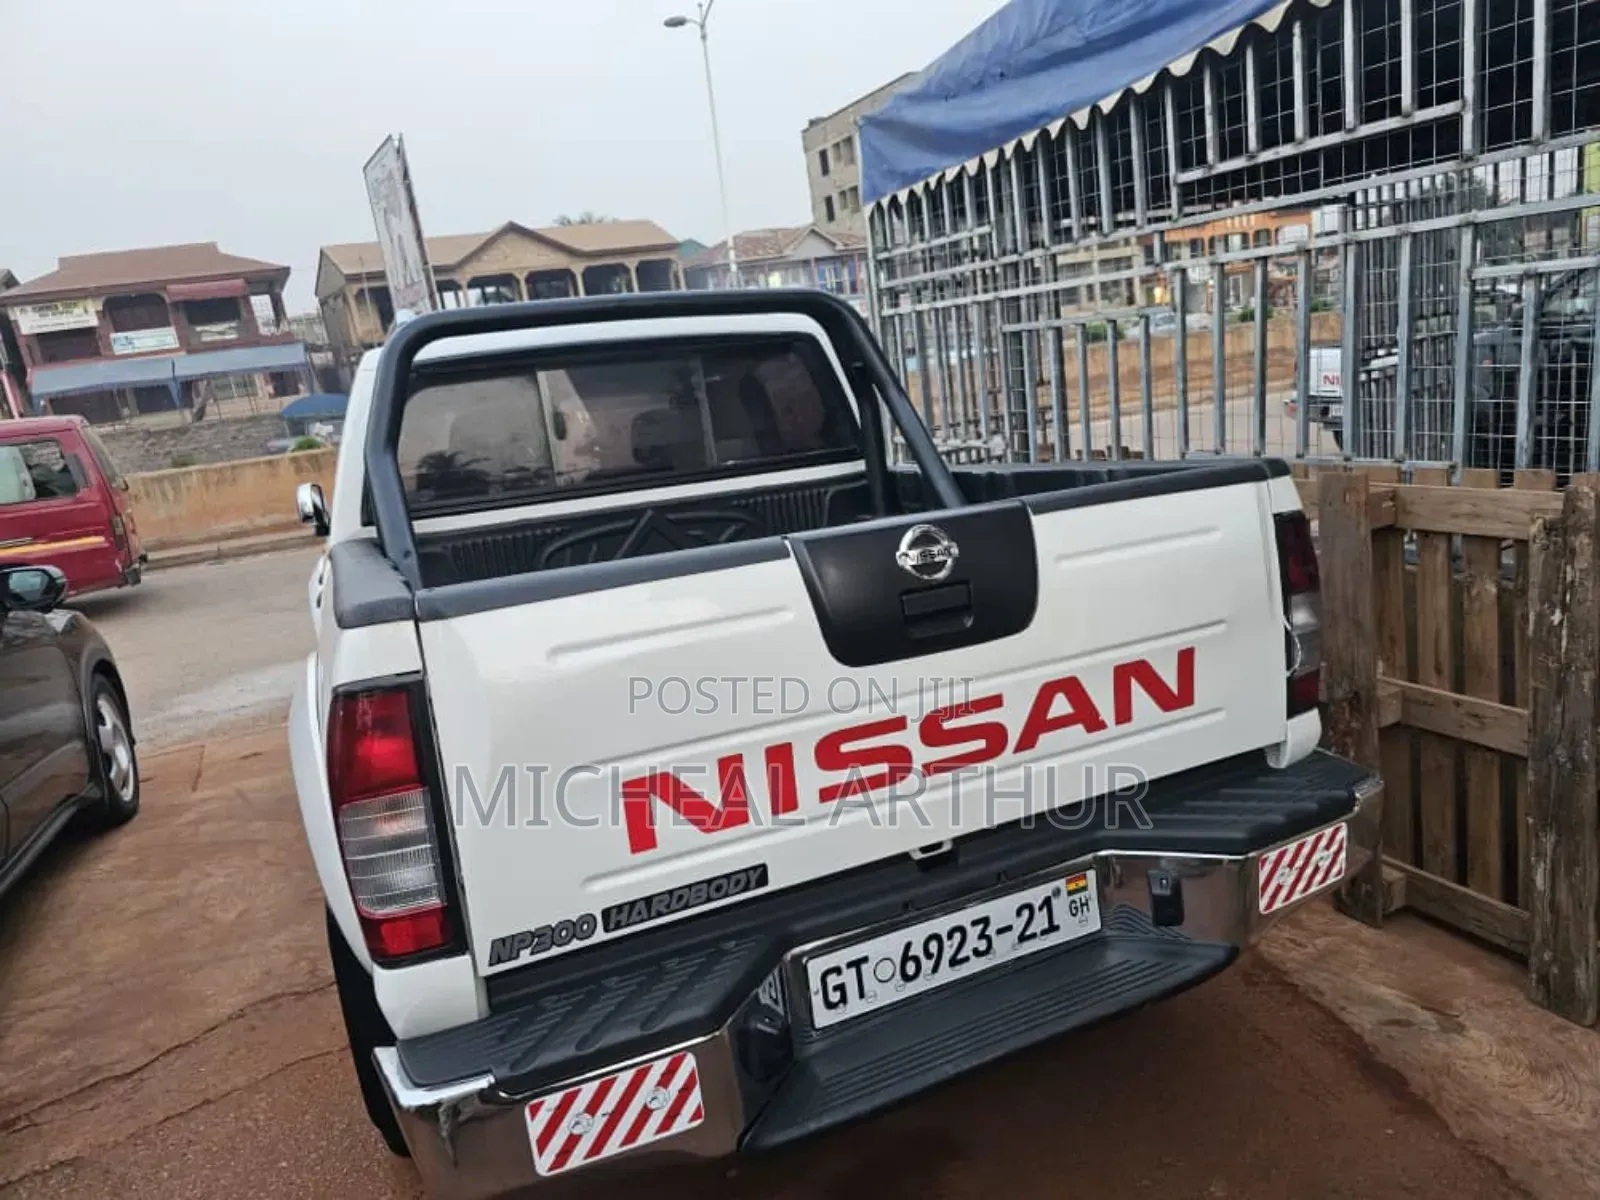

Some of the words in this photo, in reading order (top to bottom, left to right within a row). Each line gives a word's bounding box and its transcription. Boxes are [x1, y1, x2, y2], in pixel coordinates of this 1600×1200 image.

[621, 646, 1196, 855] NISSAN
[488, 913, 598, 967] NP300
[606, 866, 766, 930] HARDBODY
[819, 955, 869, 1011] GT
[899, 895, 1061, 984] 6923-21
[1069, 897, 1091, 918] GH
